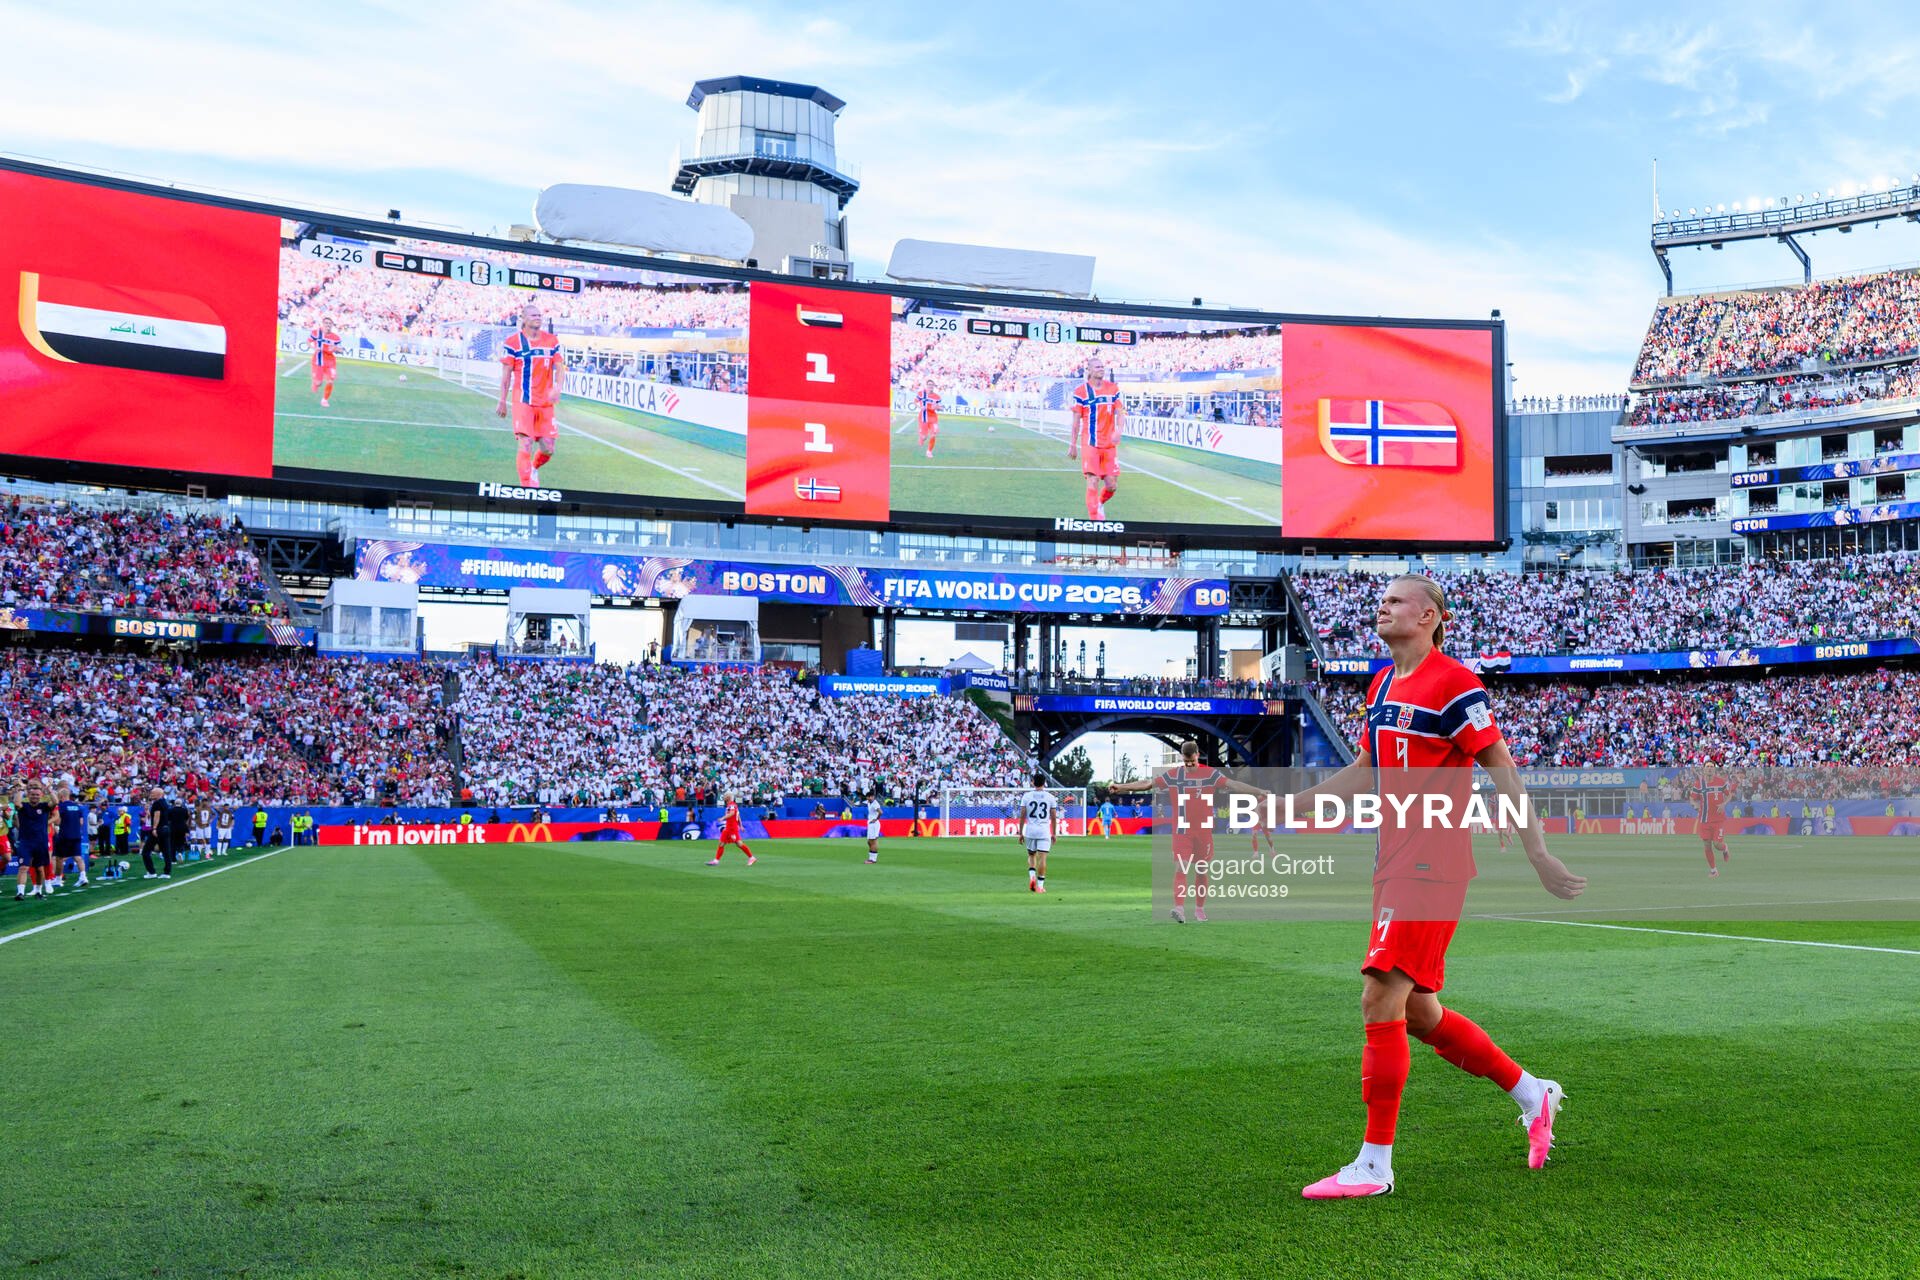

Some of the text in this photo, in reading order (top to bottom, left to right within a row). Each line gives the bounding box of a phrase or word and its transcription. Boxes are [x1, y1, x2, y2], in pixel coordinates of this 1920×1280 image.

[311, 244, 540, 287] 42:26 IRQ 1 1 NOR
[916, 316, 1102, 341] 42:26 IRQ 1 1 NOR
[806, 352, 835, 383] 1
[581, 374, 593, 396] OF
[598, 377, 657, 413] AMERICA
[804, 422, 833, 453] 1
[1138, 418, 1149, 437] OF
[1151, 420, 1203, 448] AMERICA
[1732, 472, 1768, 485] STON
[478, 481, 562, 502] Hisense
[1054, 517, 1125, 533] Hisense
[1732, 518, 1769, 531] STON
[460, 558, 565, 583] #FIFAWorldCup
[722, 571, 826, 594] BOSTON
[884, 578, 1142, 604] FIFA WORLD CUP 2026
[115, 619, 197, 638] BOSTON
[1815, 643, 1868, 659] BOSTON
[833, 682, 854, 692] FIFA
[854, 683, 887, 692] WORLD
[887, 683, 905, 693] CUP
[971, 676, 1007, 689] BOSTON
[1094, 699, 1211, 711] FIFA WORLD CUP 2026
[1396, 737, 1409, 772] 9
[1521, 774, 1549, 785] RLD
[1550, 773, 1578, 785] CUP
[1580, 772, 1625, 785] 2026
[1029, 801, 1047, 819] 23
[354, 824, 486, 845] i'm lovin' it
[1056, 819, 1069, 835] it
[1667, 818, 1676, 834] it
[1376, 907, 1394, 942] 9
